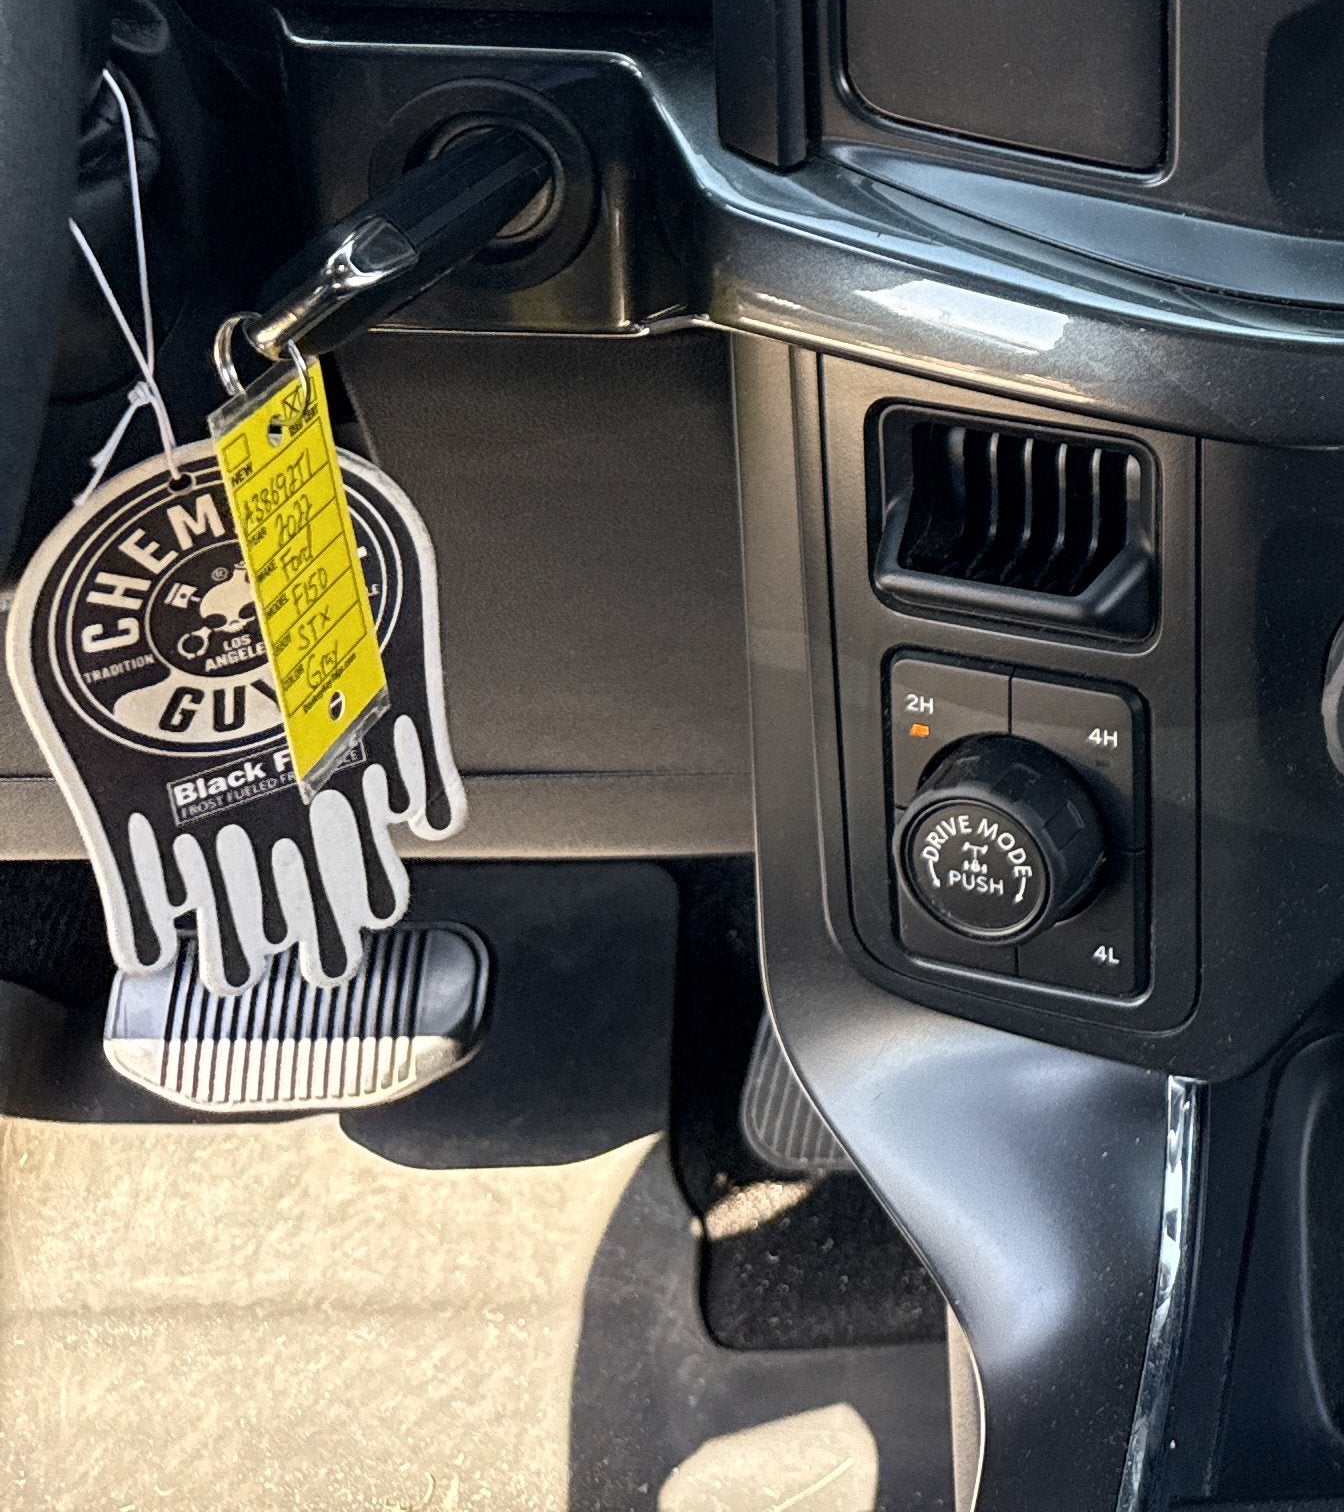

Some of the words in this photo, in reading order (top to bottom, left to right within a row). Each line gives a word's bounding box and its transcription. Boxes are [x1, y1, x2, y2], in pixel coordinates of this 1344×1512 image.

[280, 524, 314, 581] Ford
[298, 604, 332, 651] STX
[223, 633, 252, 652] LOS
[83, 653, 155, 684] TRADITION
[204, 643, 265, 672] ANGELE
[906, 694, 935, 714] 2H
[1088, 728, 1119, 748] 4H
[173, 761, 267, 807] Black
[920, 815, 972, 863] DRIVE
[976, 818, 1033, 879] MODE
[948, 869, 1004, 896] PUSH
[1093, 945, 1120, 965] 4L
